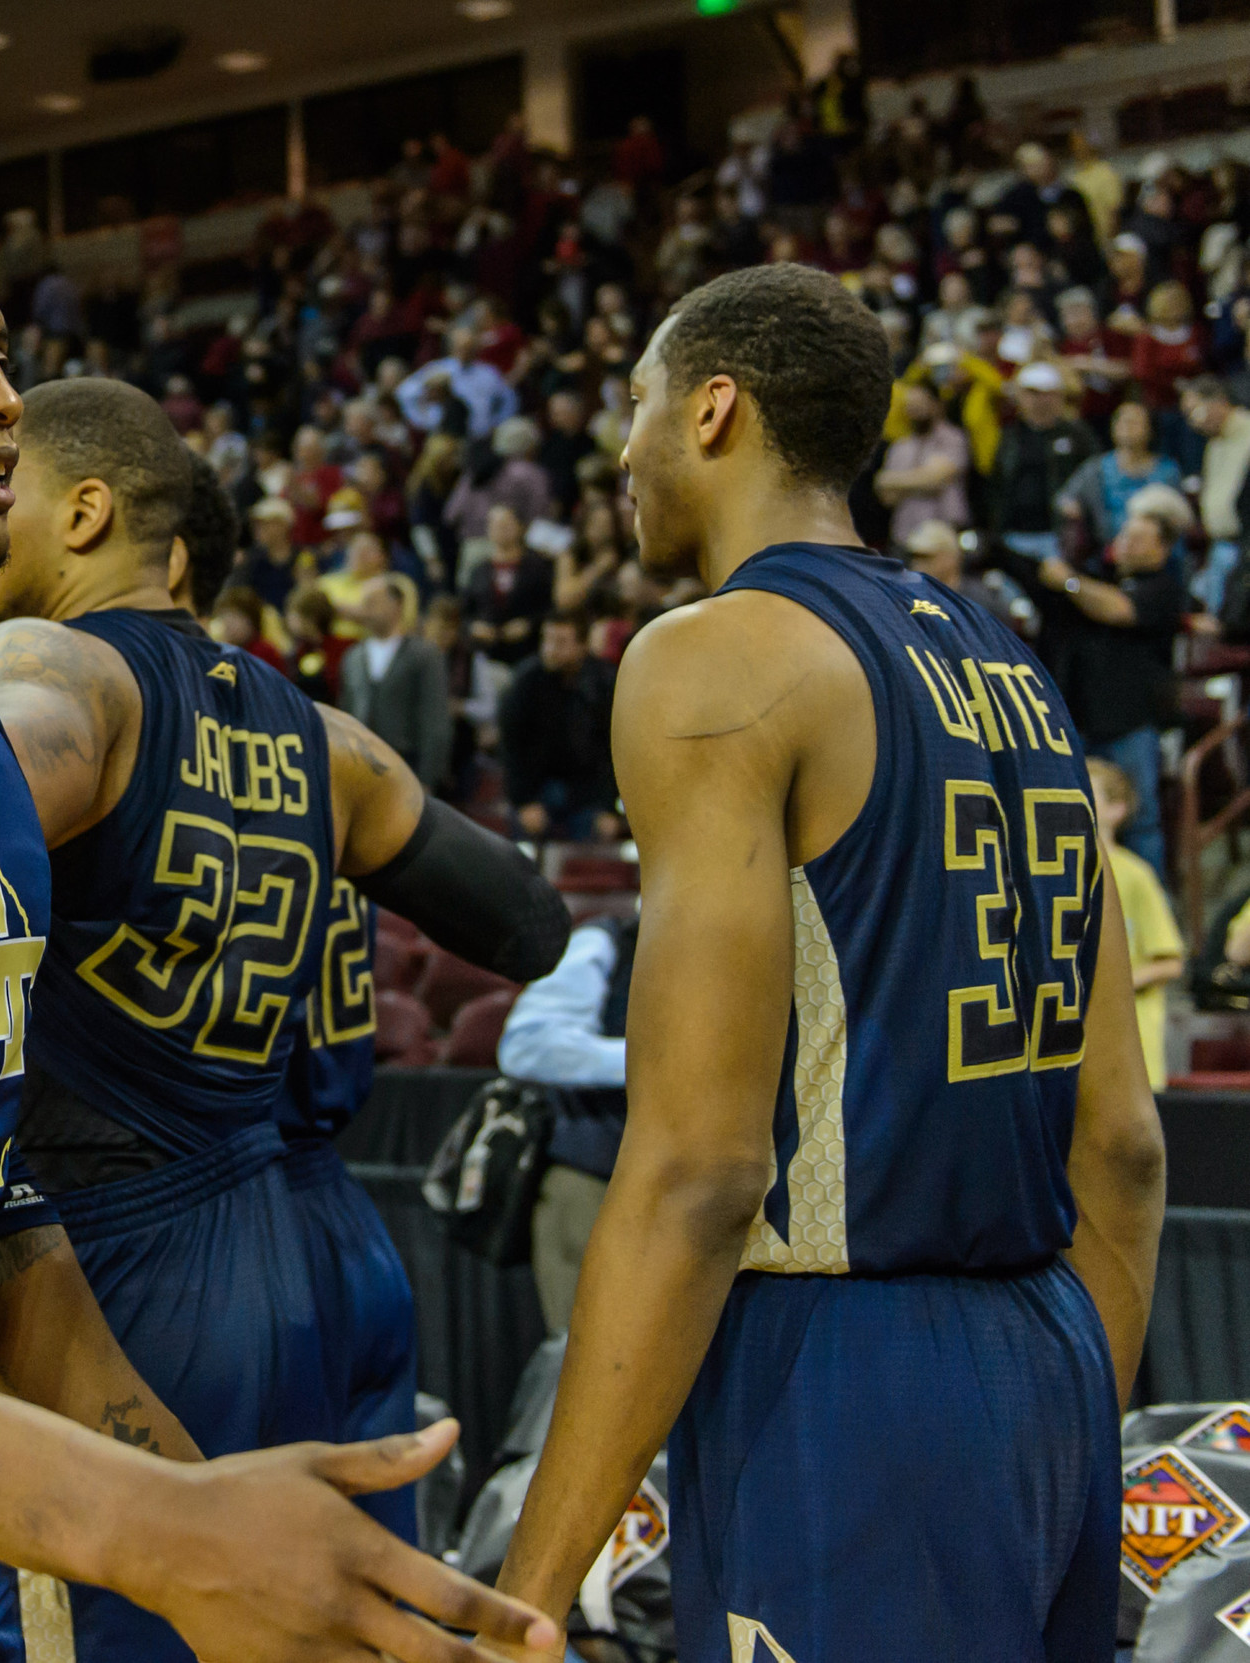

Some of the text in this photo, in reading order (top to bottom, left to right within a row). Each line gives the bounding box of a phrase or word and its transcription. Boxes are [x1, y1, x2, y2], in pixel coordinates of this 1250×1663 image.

[905, 645, 1073, 756] WHITE
[75, 810, 319, 1065] 32
[945, 779, 1103, 1084] 33
[3, 1195, 45, 1209] RUSSELL
[1122, 1504, 1209, 1538] NIT
